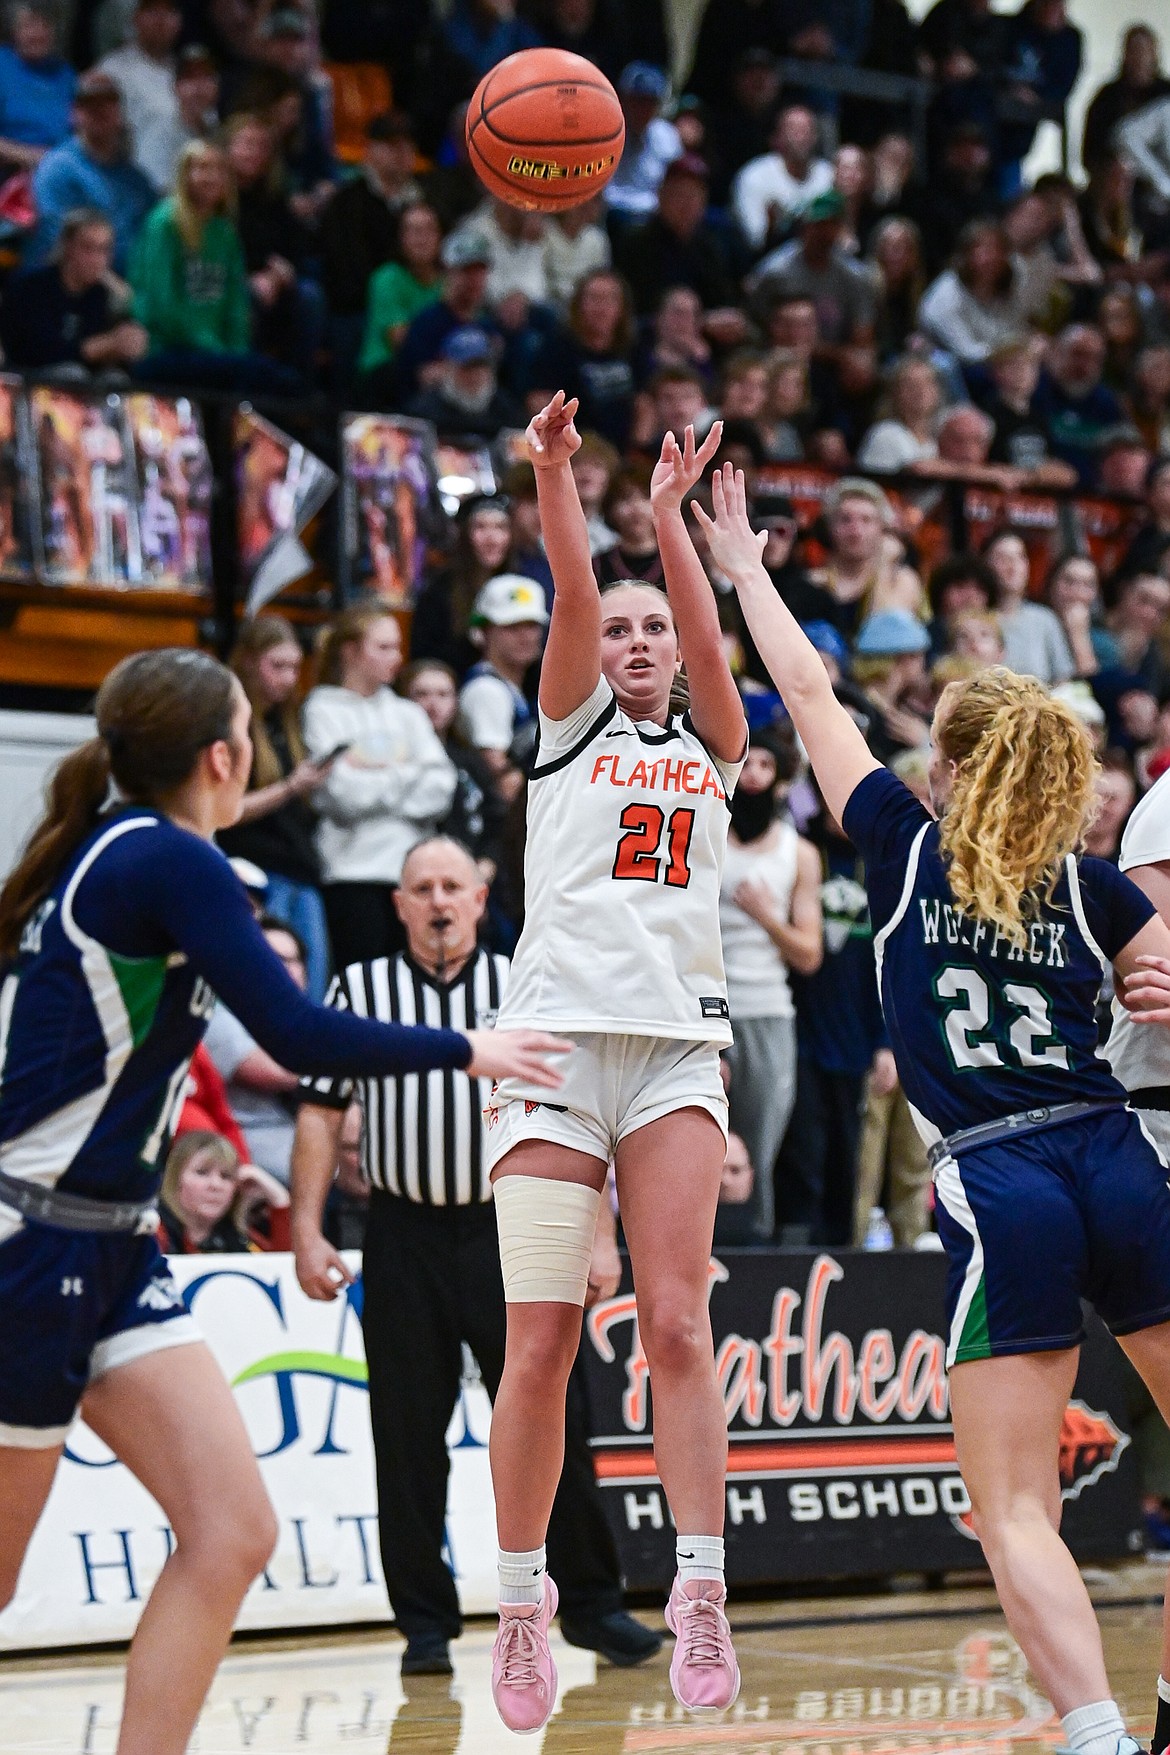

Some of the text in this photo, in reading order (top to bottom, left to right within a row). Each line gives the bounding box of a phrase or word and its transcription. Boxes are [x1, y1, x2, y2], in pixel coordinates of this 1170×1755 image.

[611, 802, 696, 890] 21
[935, 966, 1071, 1072] 22
[623, 1486, 767, 1531] HH
[787, 1477, 972, 1521] SCHOO
